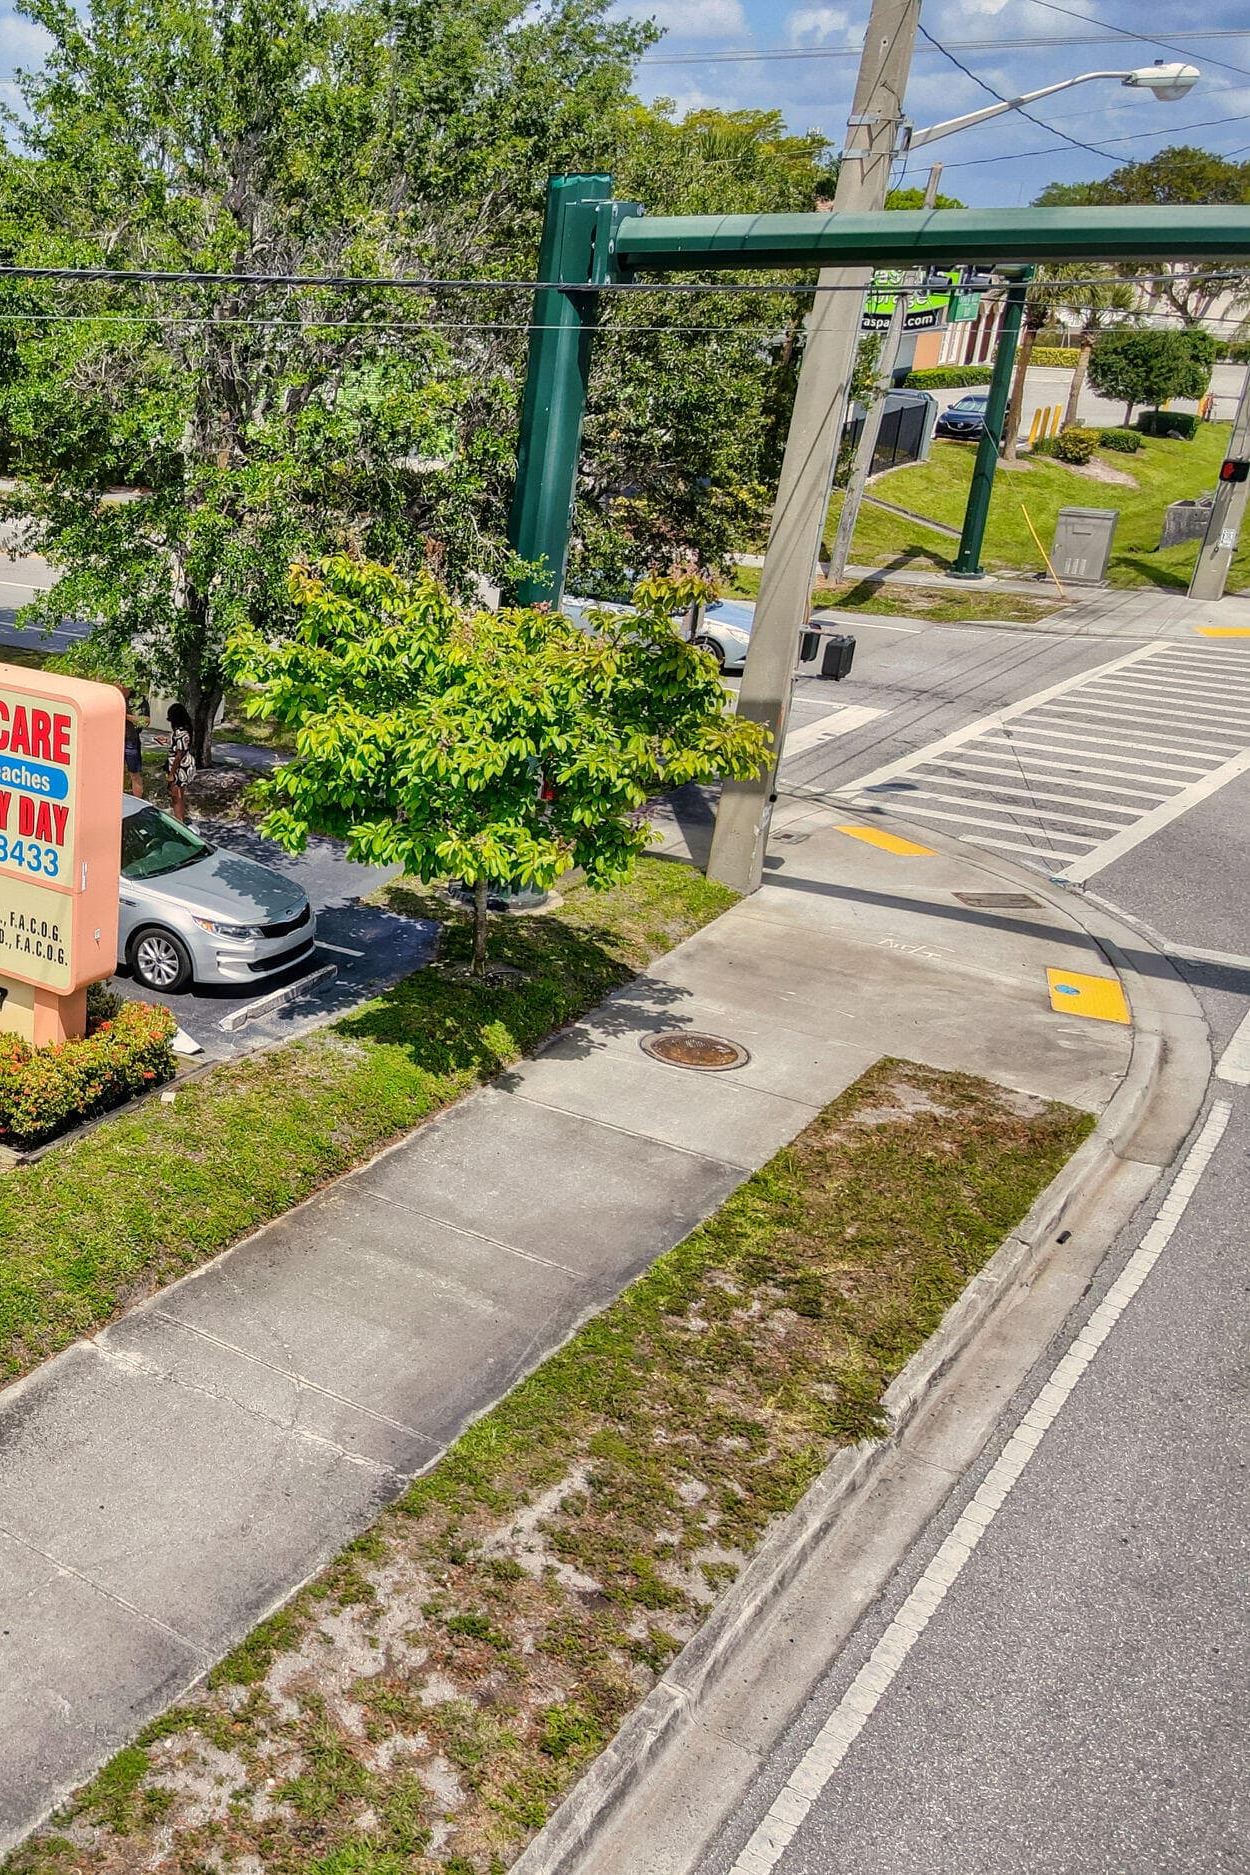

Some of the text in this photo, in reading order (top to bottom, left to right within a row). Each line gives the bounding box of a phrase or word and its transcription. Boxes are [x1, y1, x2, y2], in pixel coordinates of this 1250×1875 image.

[20, 796, 69, 846] DAY
[10, 911, 62, 943] F.A.C.O.G.
[16, 934, 68, 966] F.A.C.O.G.
